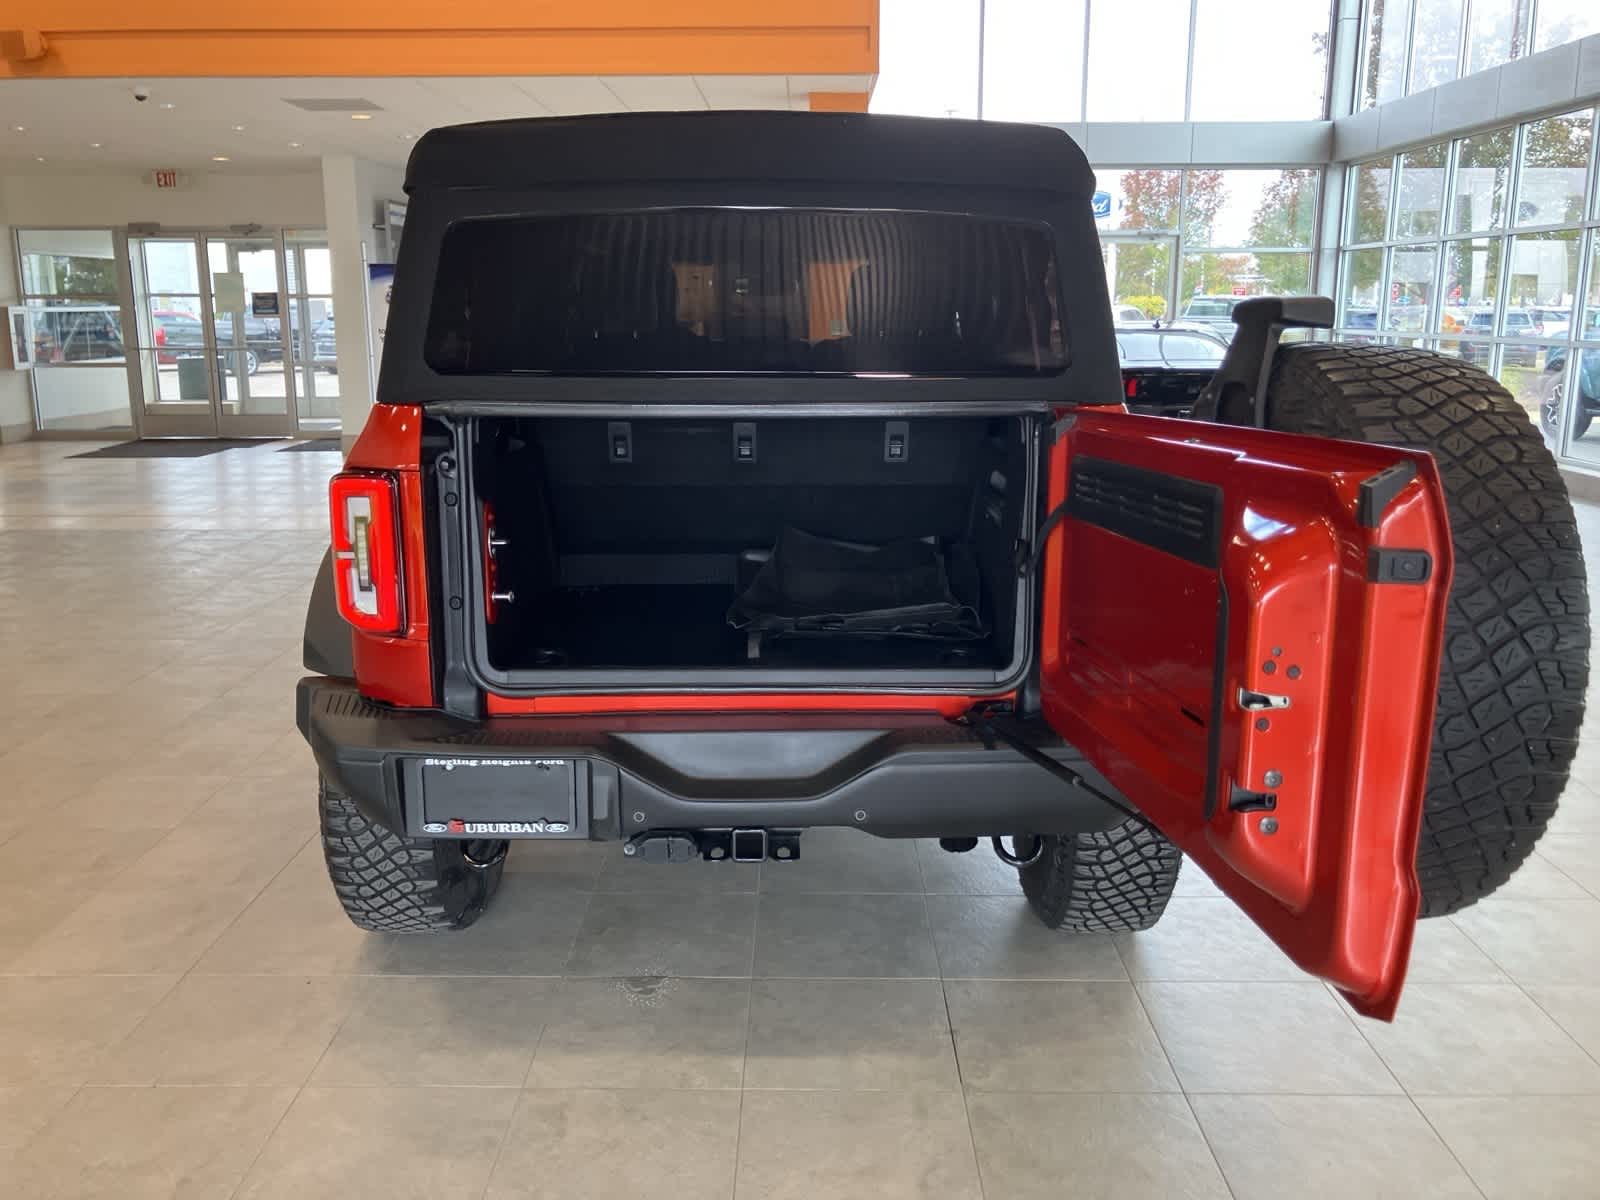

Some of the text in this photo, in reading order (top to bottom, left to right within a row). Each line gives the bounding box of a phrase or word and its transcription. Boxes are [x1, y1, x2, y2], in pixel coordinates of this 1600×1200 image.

[156, 171, 177, 188] EXIT
[425, 758, 479, 767] Sterling
[448, 820, 544, 833] SUBURBAN
